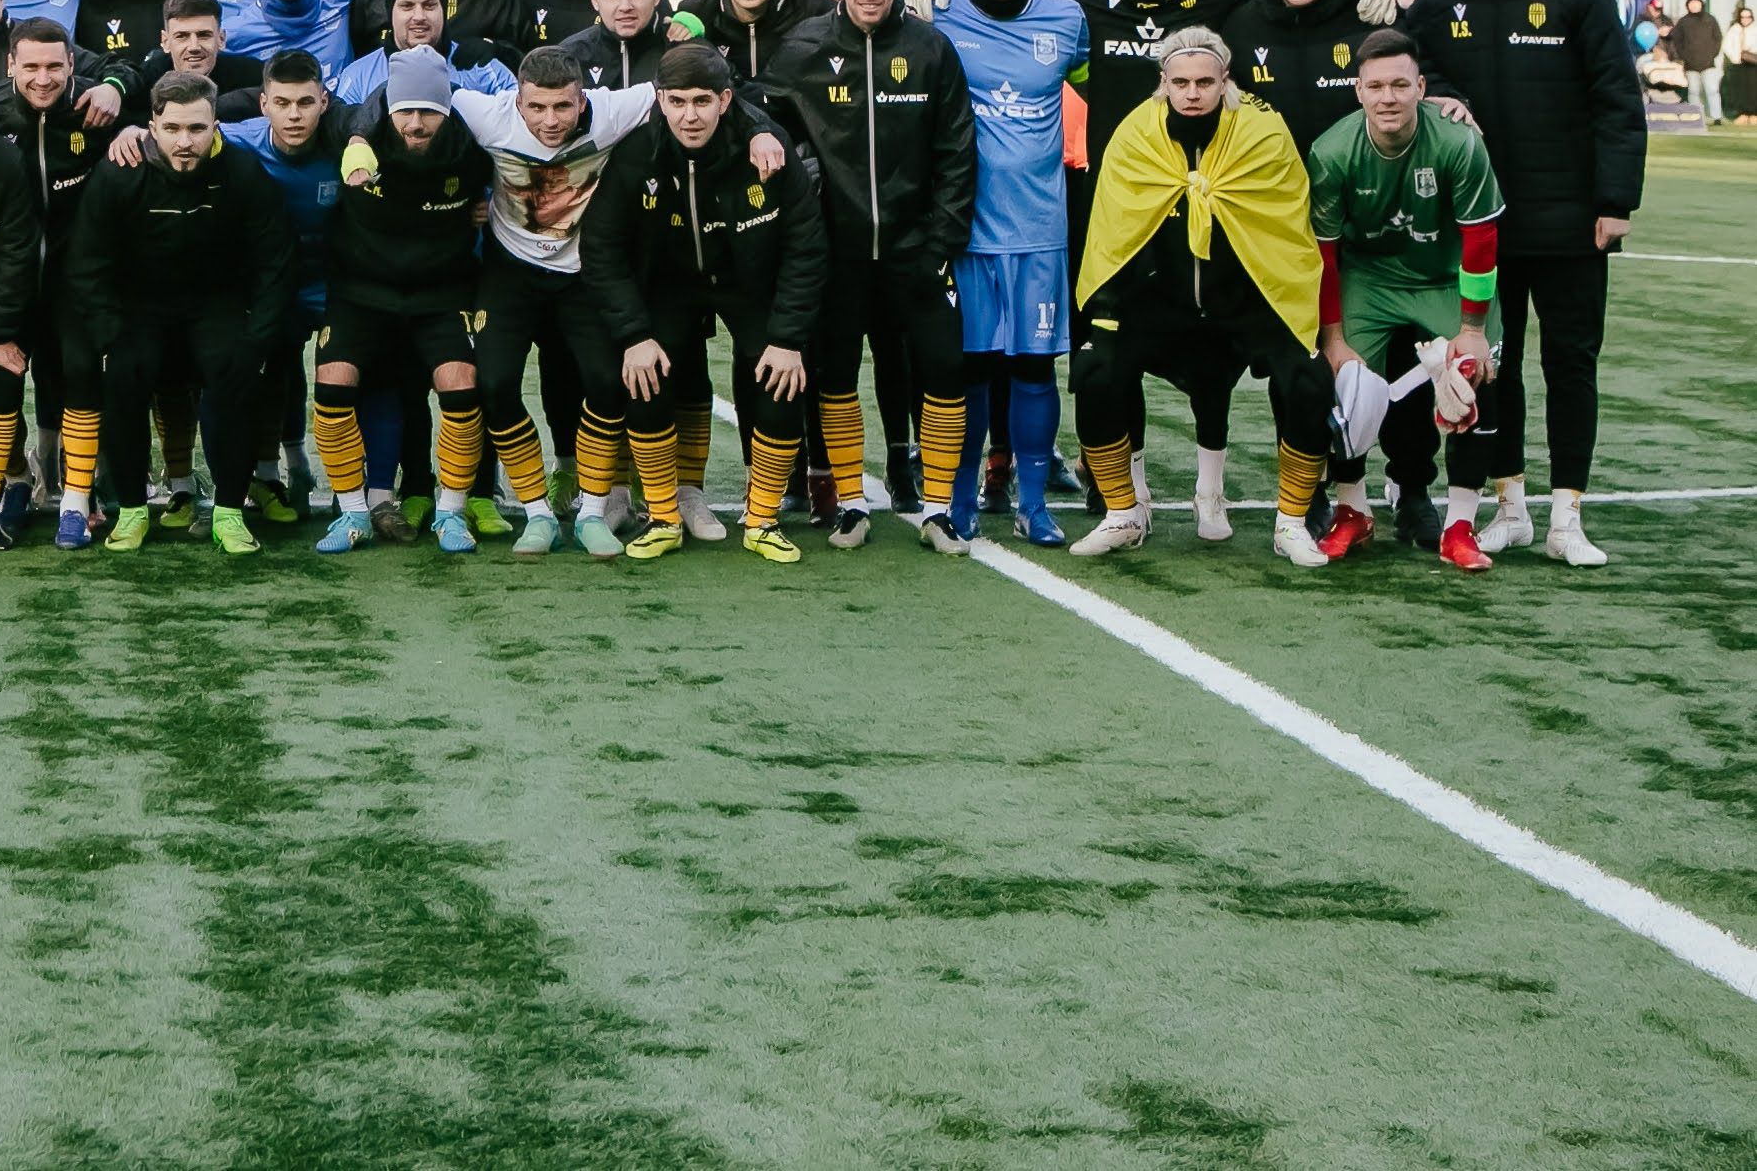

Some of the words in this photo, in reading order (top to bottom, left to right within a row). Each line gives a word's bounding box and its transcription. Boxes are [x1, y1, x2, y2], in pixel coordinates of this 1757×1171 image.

[1450, 21, 1473, 38] V.S.
[1521, 35, 1566, 46] FAVBET
[1252, 65, 1275, 83] D.L.
[828, 86, 852, 103] V.H.
[888, 93, 929, 103] FAVBET
